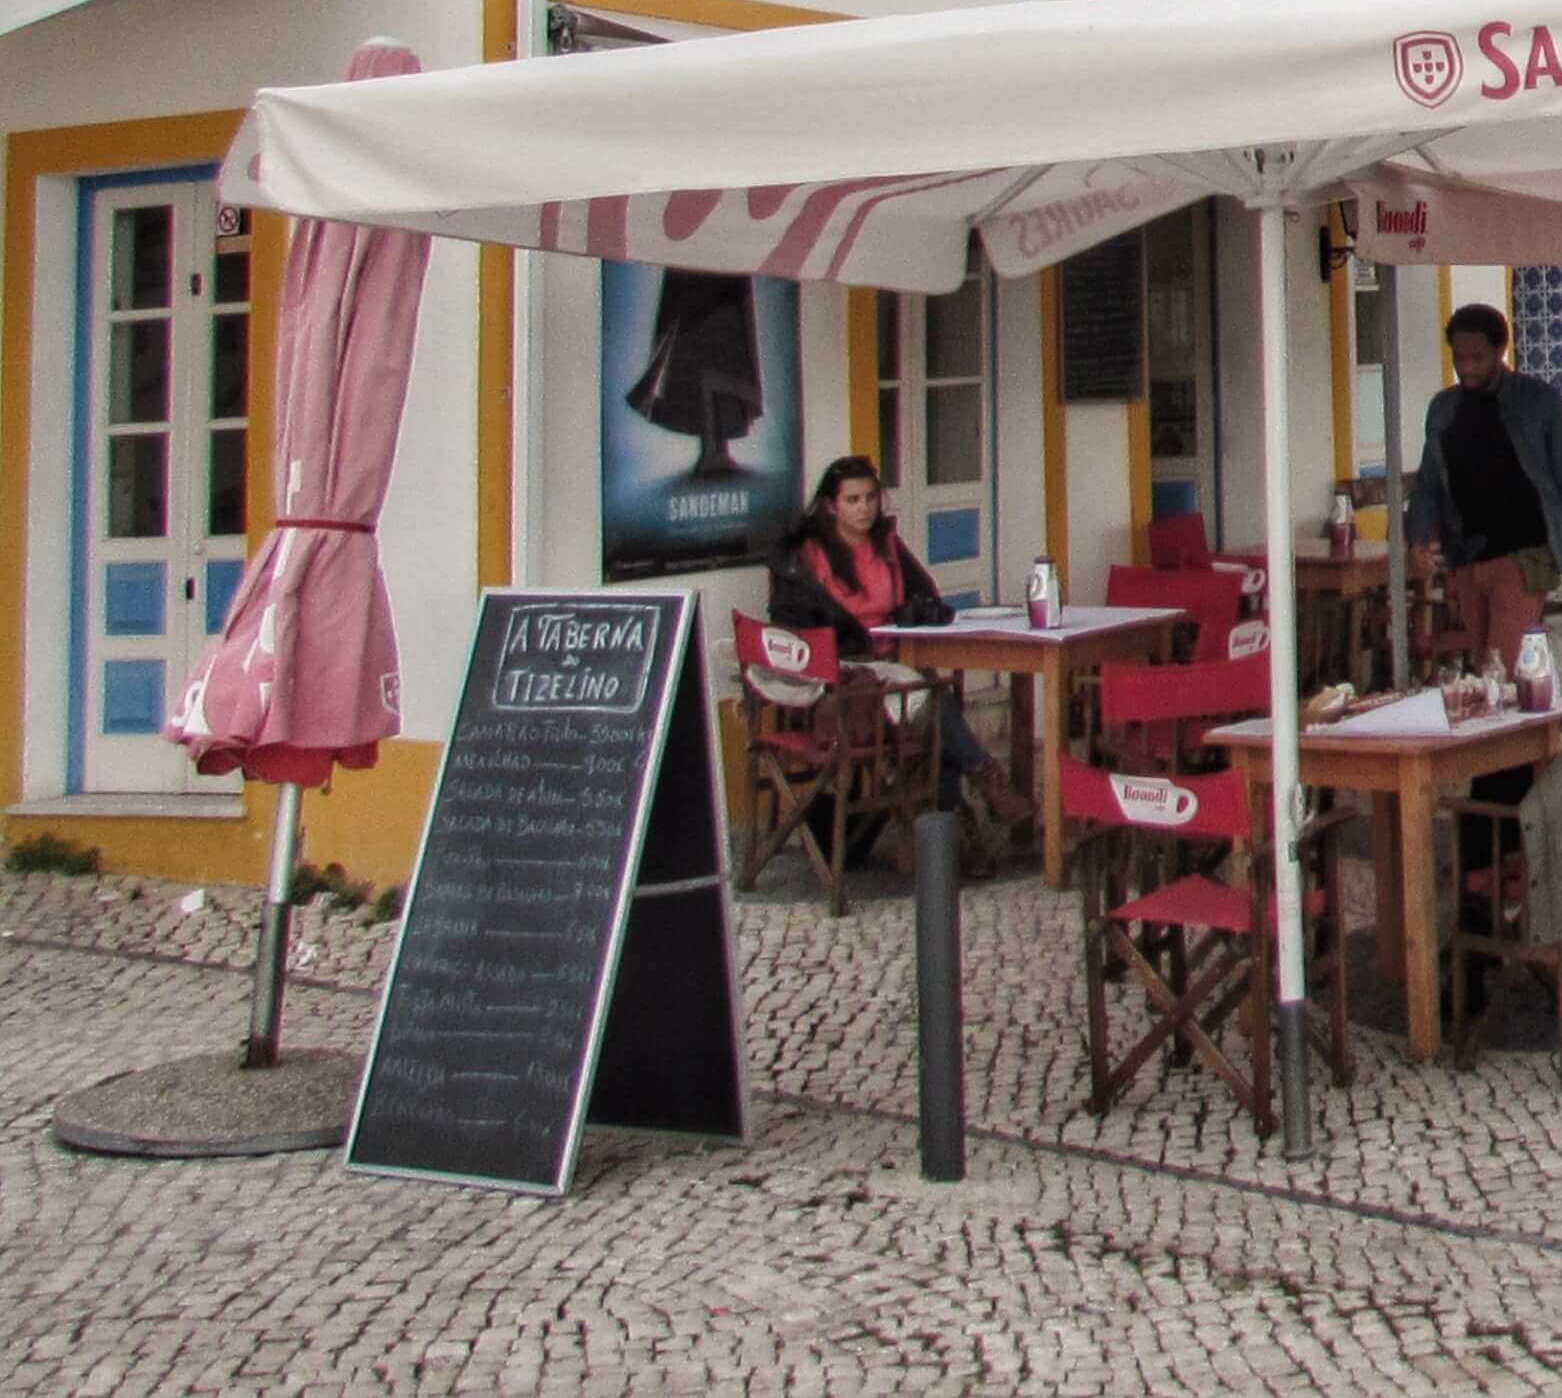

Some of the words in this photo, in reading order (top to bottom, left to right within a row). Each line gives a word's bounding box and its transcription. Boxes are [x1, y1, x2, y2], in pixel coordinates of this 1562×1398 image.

[667, 490, 750, 522] SANDEMAN
[507, 614, 530, 655] A
[537, 612, 646, 654] TABERNA
